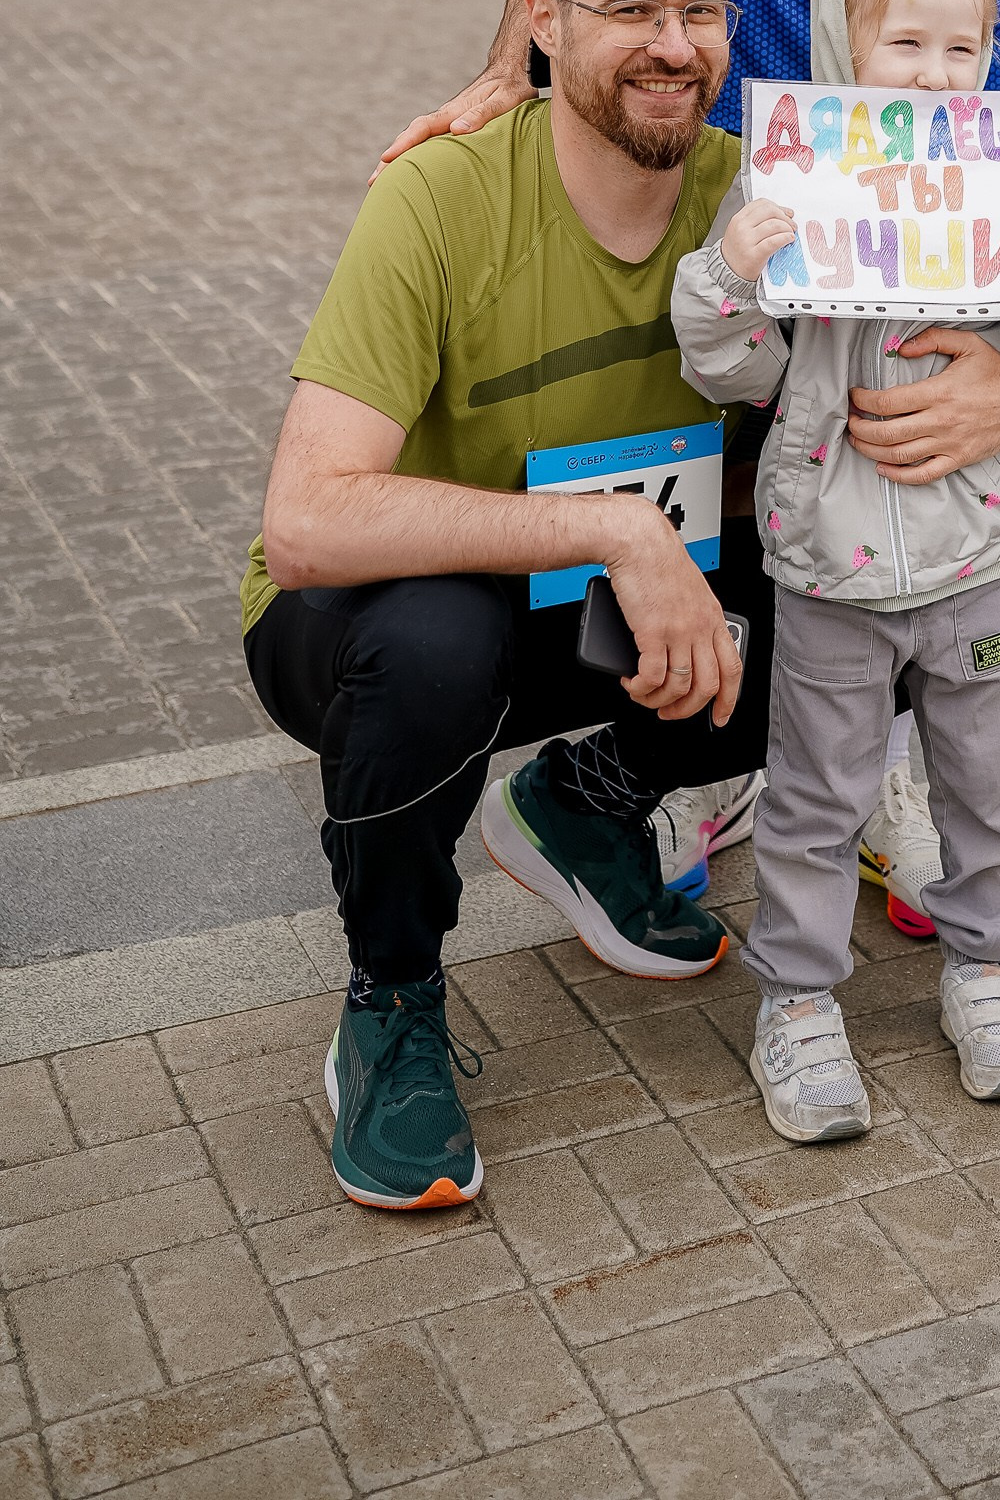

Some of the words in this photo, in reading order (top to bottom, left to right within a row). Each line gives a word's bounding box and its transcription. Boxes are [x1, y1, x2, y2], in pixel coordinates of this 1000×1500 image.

[752, 93, 914, 175] ДЯДЯ
[856, 163, 964, 213] ТЫ
[580, 454, 606, 466] СБЕР
